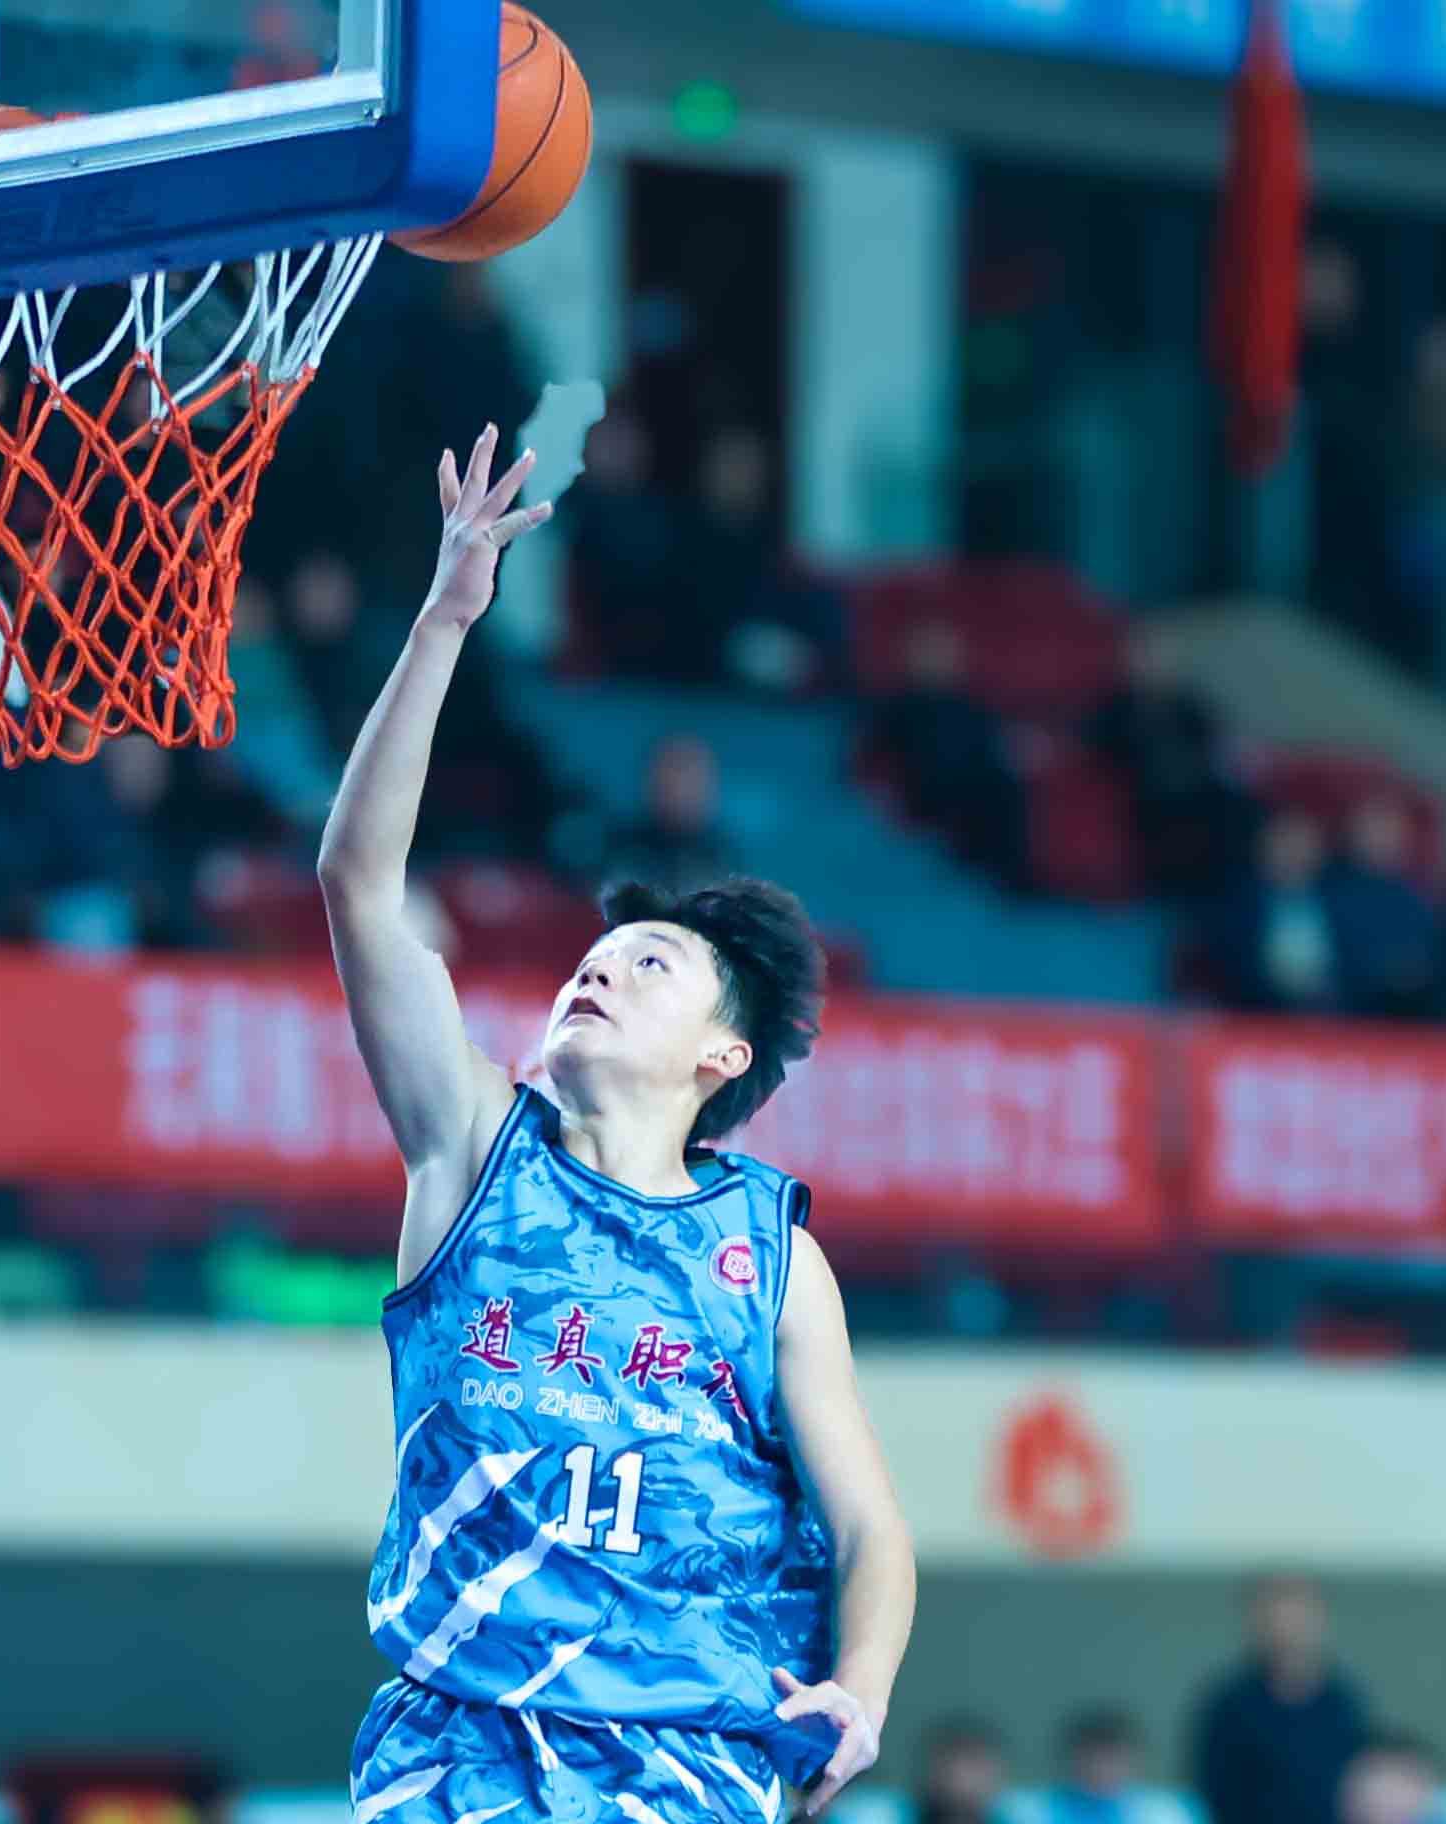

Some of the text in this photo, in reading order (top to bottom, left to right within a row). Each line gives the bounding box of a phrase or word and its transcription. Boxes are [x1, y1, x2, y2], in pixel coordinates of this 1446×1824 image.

[460, 1378, 523, 1410] DAO
[535, 1386, 620, 1425] ZHEN
[631, 1401, 684, 1434] ZHI
[555, 1444, 644, 1555] 11
